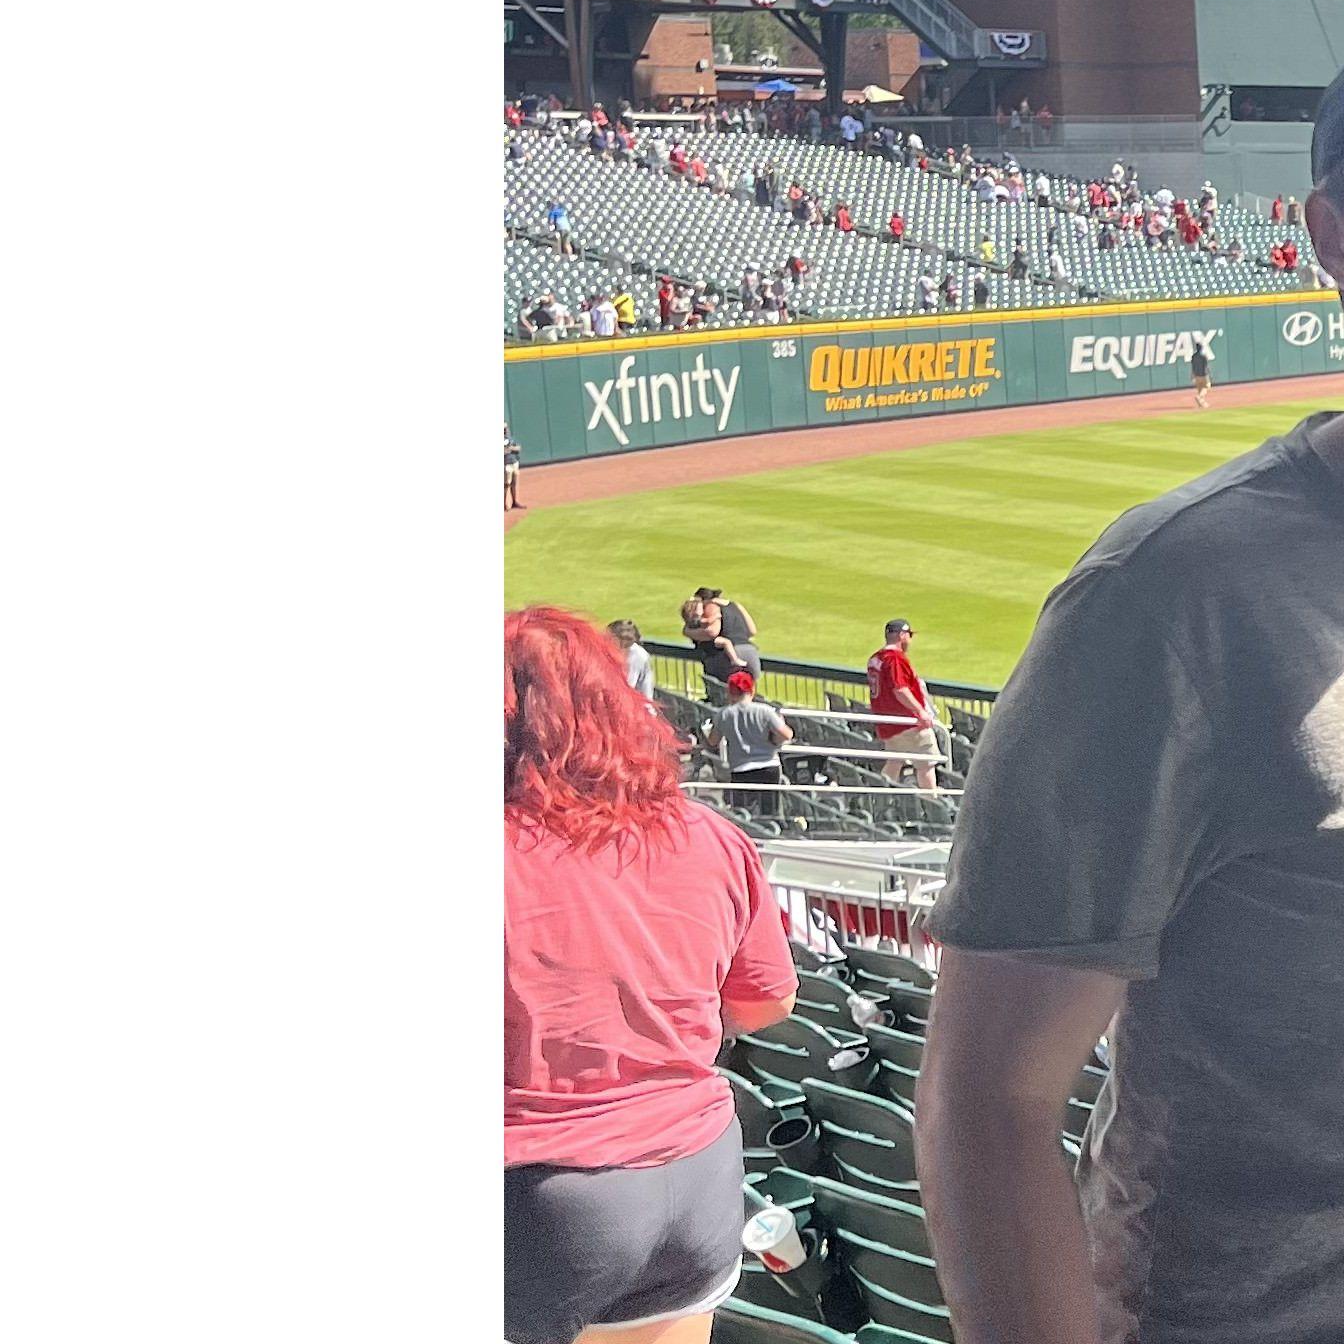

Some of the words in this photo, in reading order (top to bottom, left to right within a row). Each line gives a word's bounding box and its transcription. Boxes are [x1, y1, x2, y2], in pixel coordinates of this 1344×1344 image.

[772, 340, 797, 358] 385
[809, 337, 997, 394] QUIKRETE
[1070, 328, 1218, 380] EQUIFAX
[584, 353, 741, 446] xfinity
[825, 394, 862, 412] What
[864, 389, 929, 409] America's
[931, 385, 967, 401] Made
